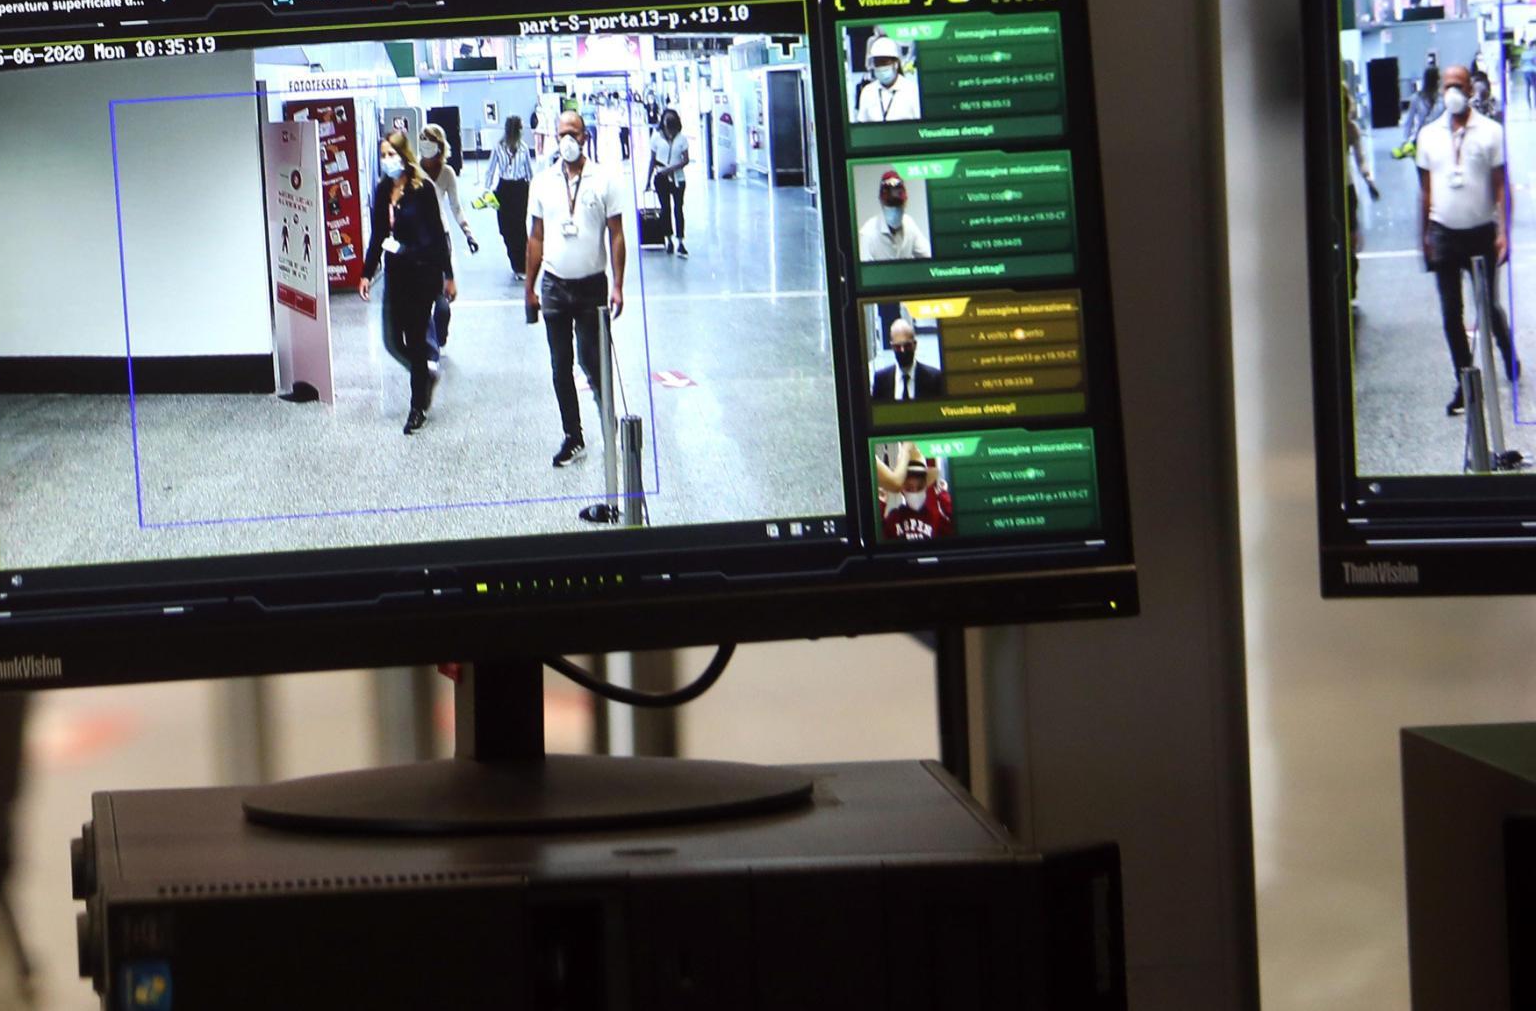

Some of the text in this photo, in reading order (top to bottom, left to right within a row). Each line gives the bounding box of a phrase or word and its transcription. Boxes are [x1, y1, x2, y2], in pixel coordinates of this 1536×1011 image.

[518, 4, 750, 36] part-S-porta13-p.+19.10
[93, 42, 126, 60] Mon
[135, 36, 216, 58] 10:35:19
[288, 77, 349, 93] FOTOTESSERA
[918, 124, 995, 139] Visualizza dettagli
[929, 263, 1006, 278] Visualizza dettagli
[940, 402, 1017, 418] Visualizza dettagli
[1341, 560, 1419, 584] ThinkVision
